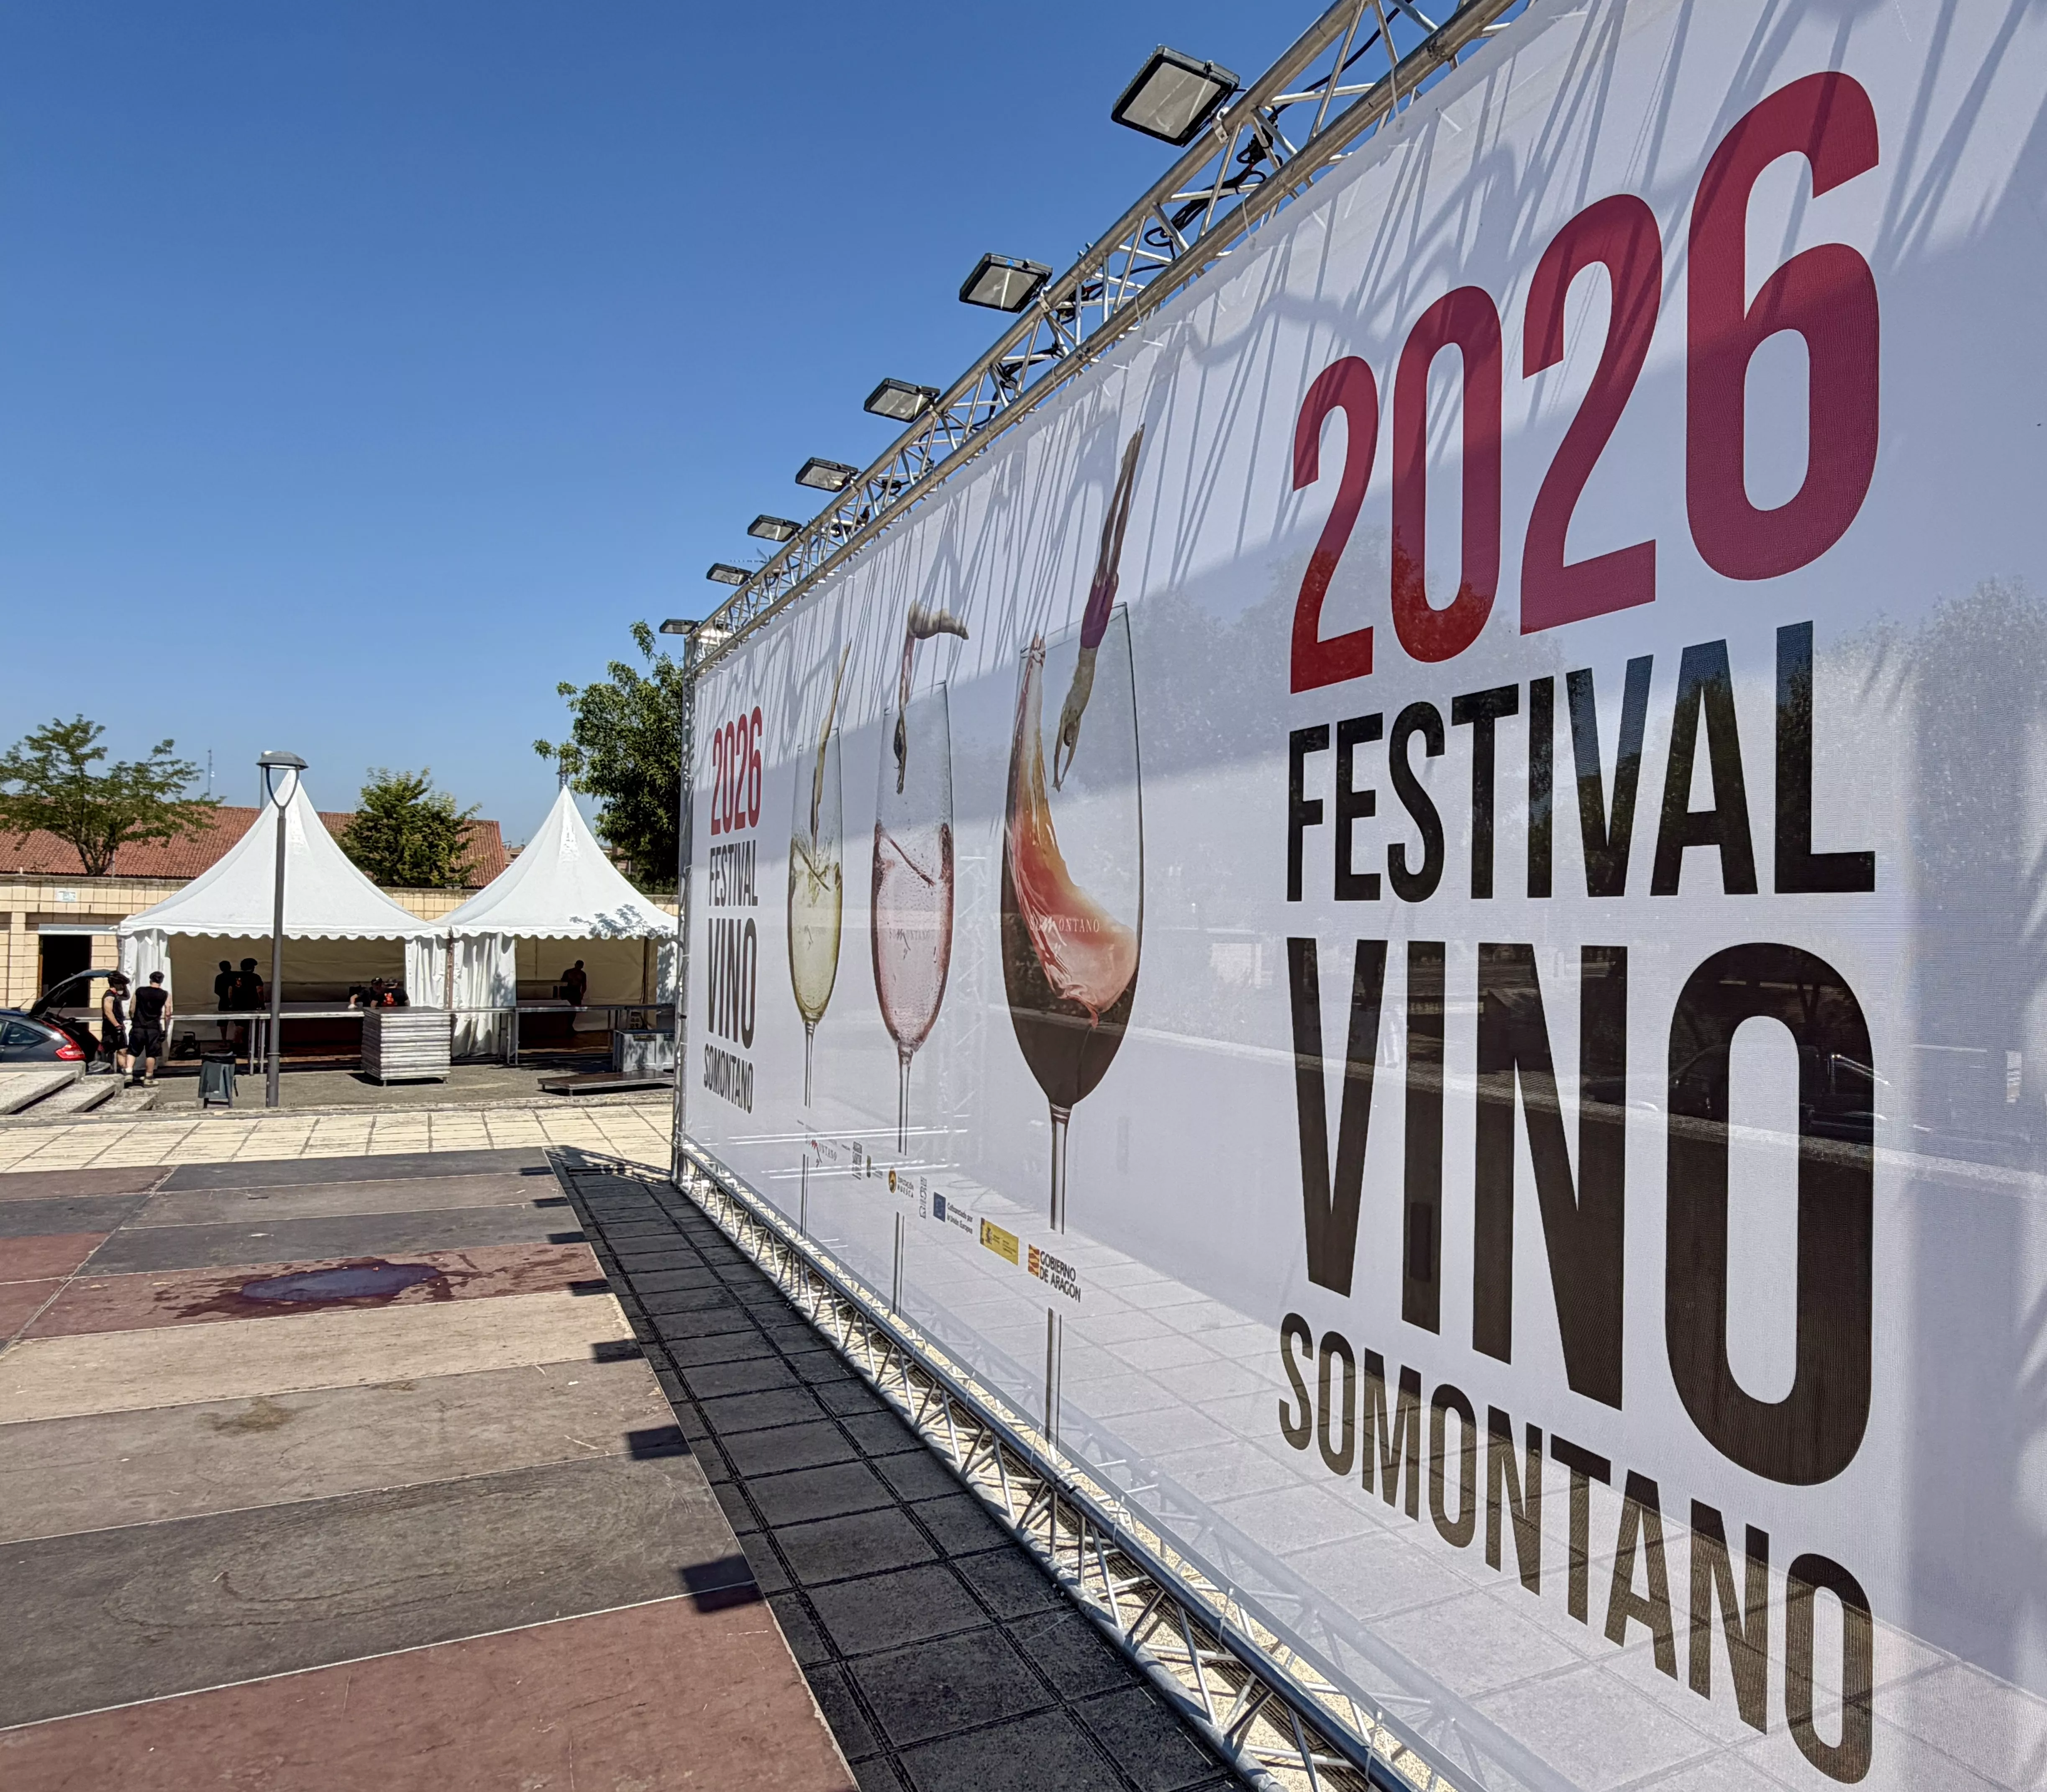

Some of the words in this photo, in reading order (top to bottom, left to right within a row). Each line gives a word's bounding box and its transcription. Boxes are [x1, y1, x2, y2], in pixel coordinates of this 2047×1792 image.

[1290, 71, 1880, 694] 2026
[711, 706, 763, 836] 2026
[1286, 620, 1875, 903] FESTIVAL
[708, 840, 758, 907] FESTIVAL
[708, 917, 757, 1049] VINO
[704, 1043, 753, 1114] SOMONTANO
[1039, 1266, 1048, 1283] DE
[1040, 1251, 1076, 1282] GOBIERNO
[1286, 937, 1874, 1486] VINO
[1279, 1312, 1873, 1784] SOMONTANO
